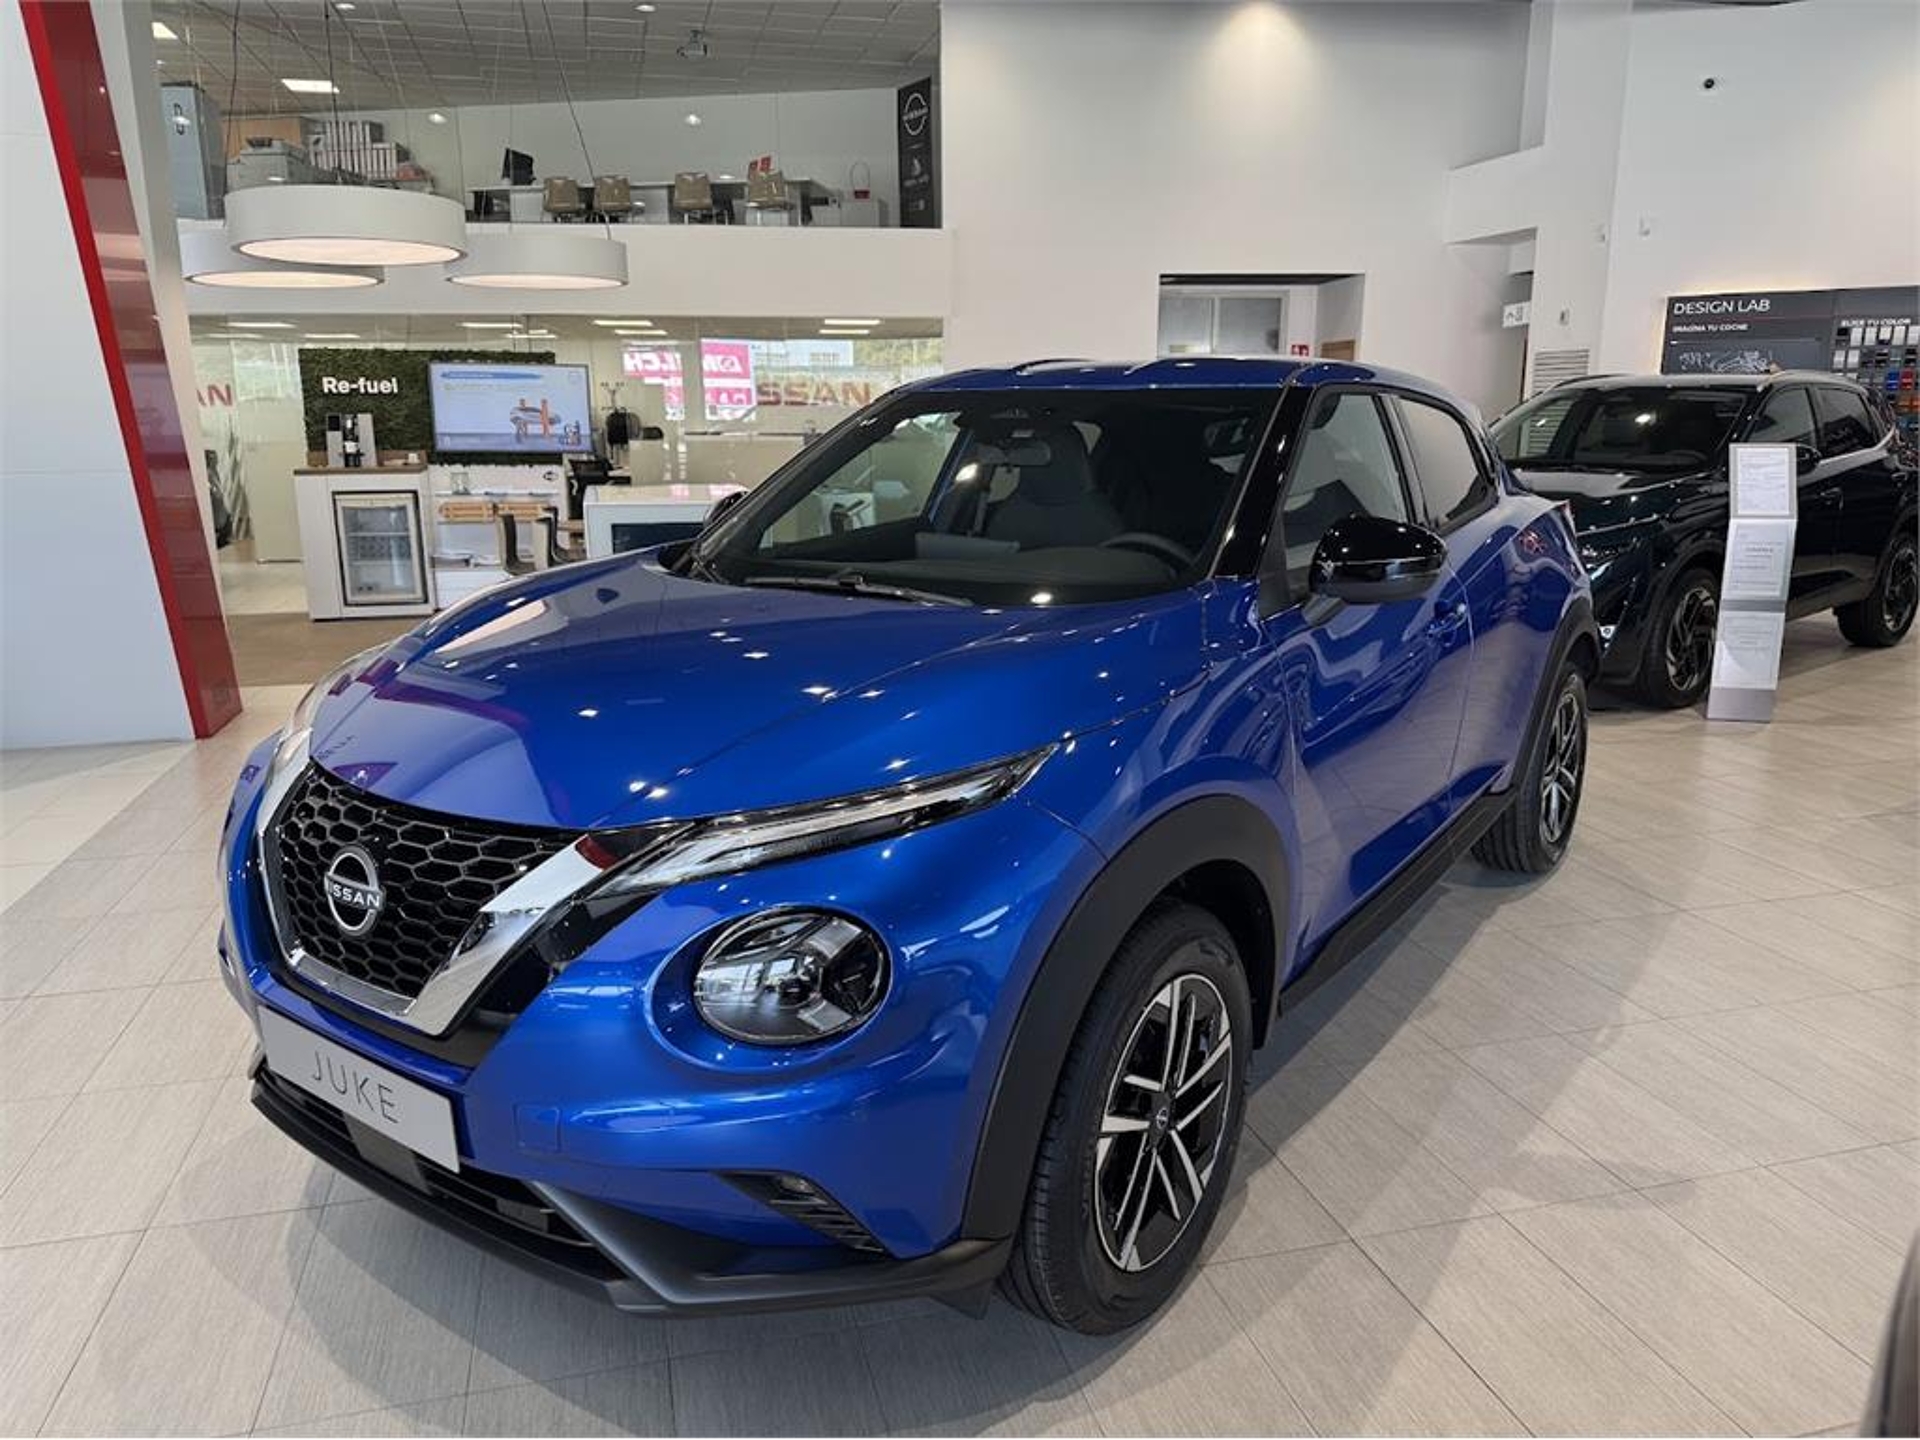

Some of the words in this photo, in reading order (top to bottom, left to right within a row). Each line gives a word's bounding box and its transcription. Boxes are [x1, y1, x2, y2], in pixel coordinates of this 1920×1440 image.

[1673, 300, 1734, 315] DESIGN
[1738, 298, 1771, 312] LAB
[321, 376, 398, 394] Re-fuel
[312, 1050, 399, 1125] JUKE
